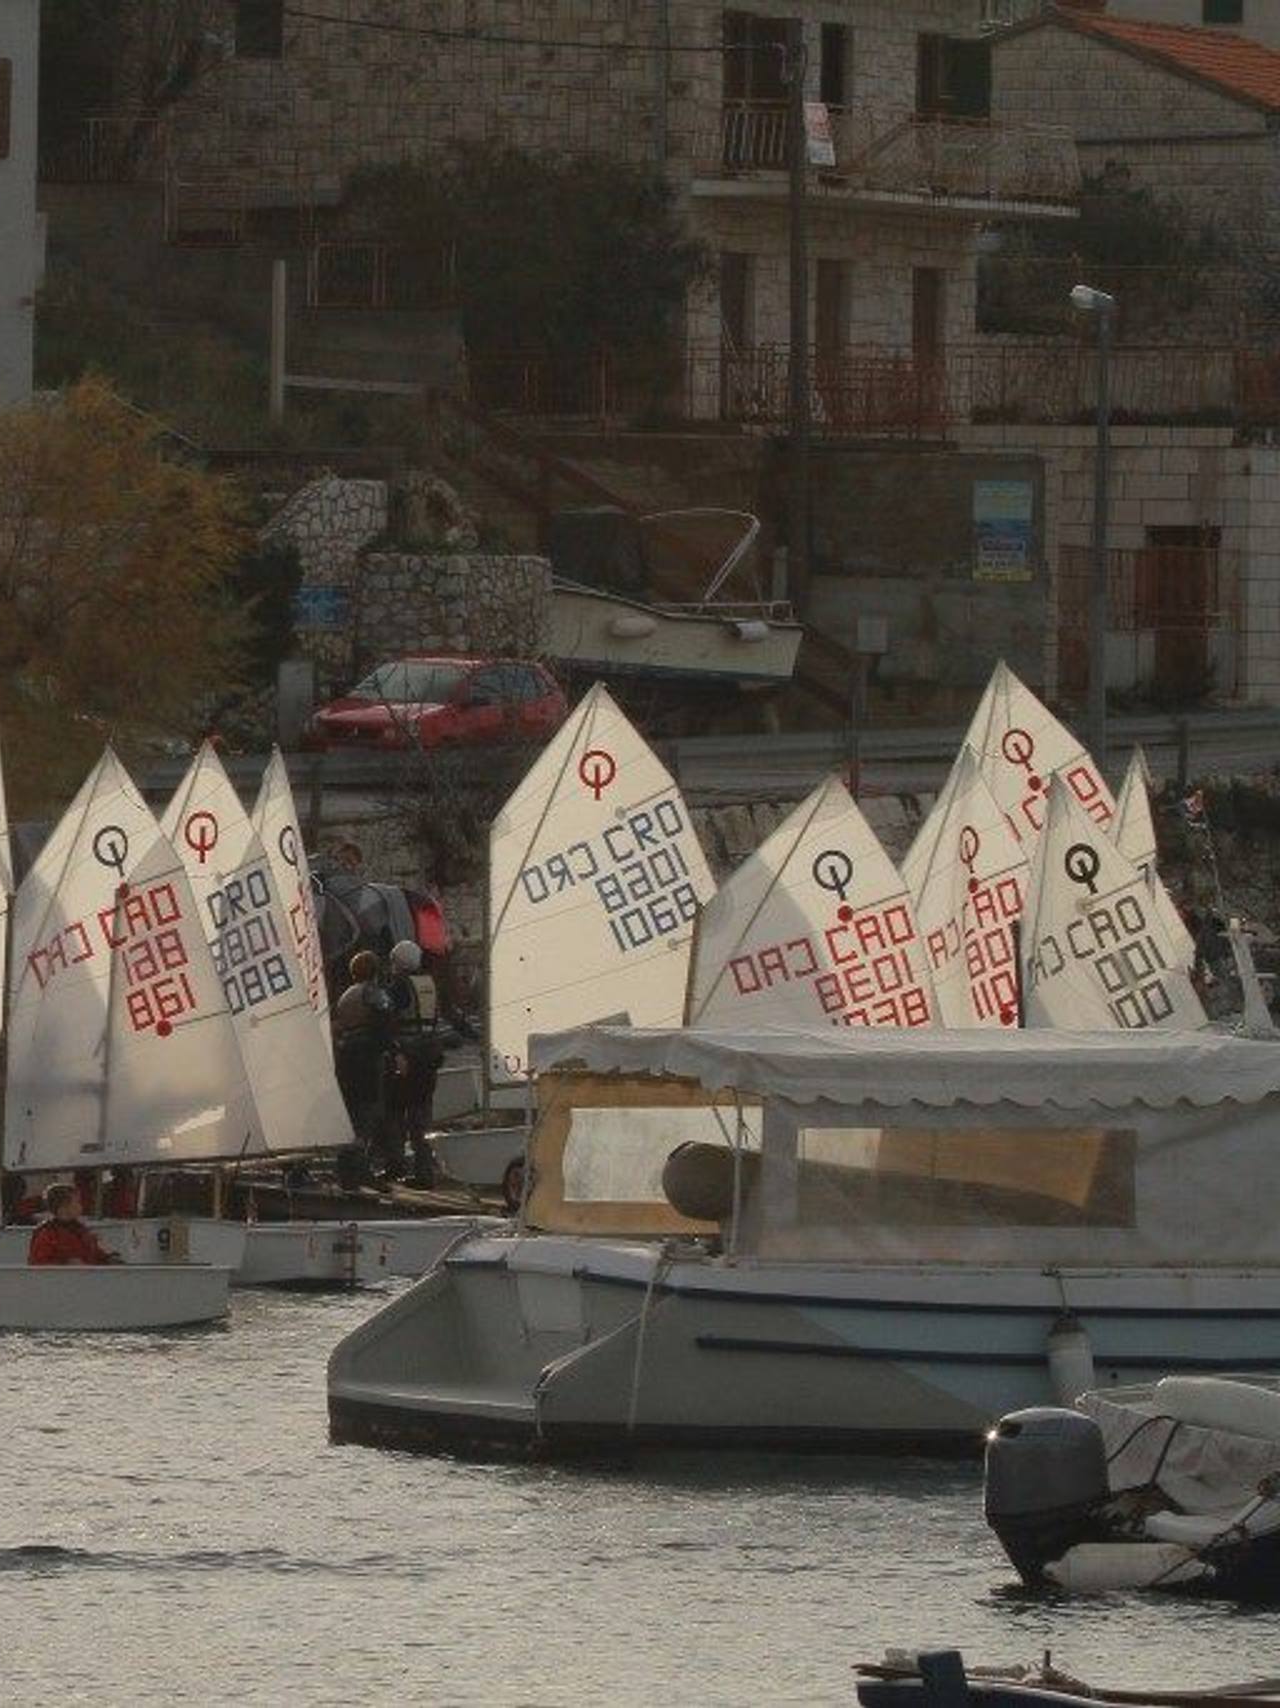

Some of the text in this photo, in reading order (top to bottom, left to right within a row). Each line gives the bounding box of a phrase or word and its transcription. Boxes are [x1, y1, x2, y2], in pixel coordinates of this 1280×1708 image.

[602, 799, 683, 863] CRO
[206, 869, 270, 928] CRO
[608, 883, 701, 953] 1068
[126, 972, 196, 1032] 861
